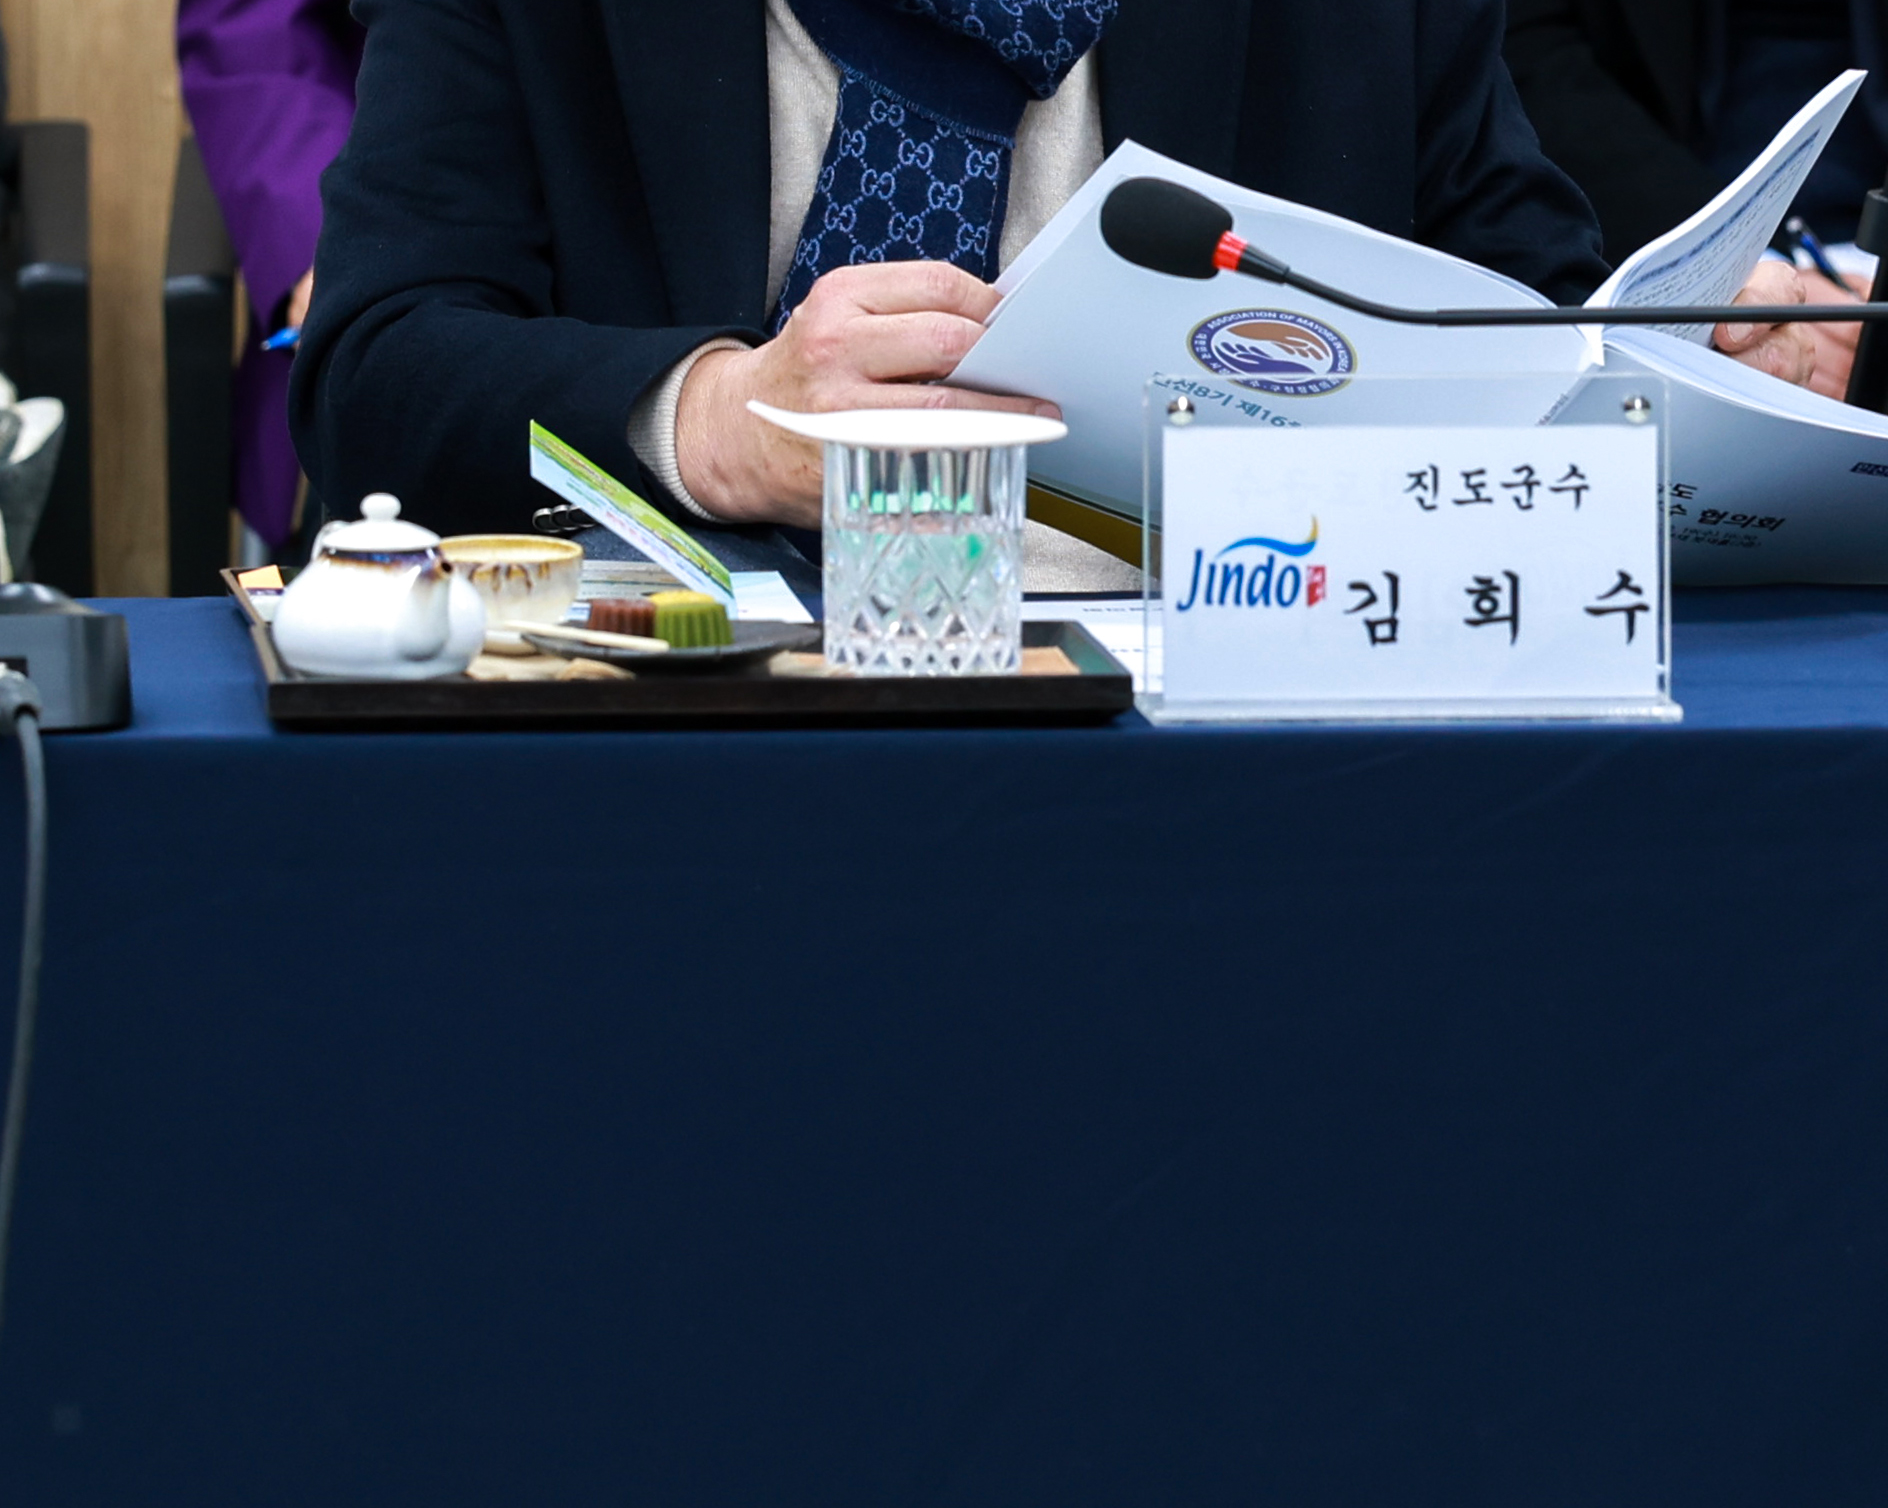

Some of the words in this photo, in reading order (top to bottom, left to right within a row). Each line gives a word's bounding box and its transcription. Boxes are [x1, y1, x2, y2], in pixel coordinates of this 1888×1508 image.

[1279, 313, 1296, 322] OF
[1404, 463, 1590, 512] 진도군수
[1176, 548, 1302, 612] Jindo
